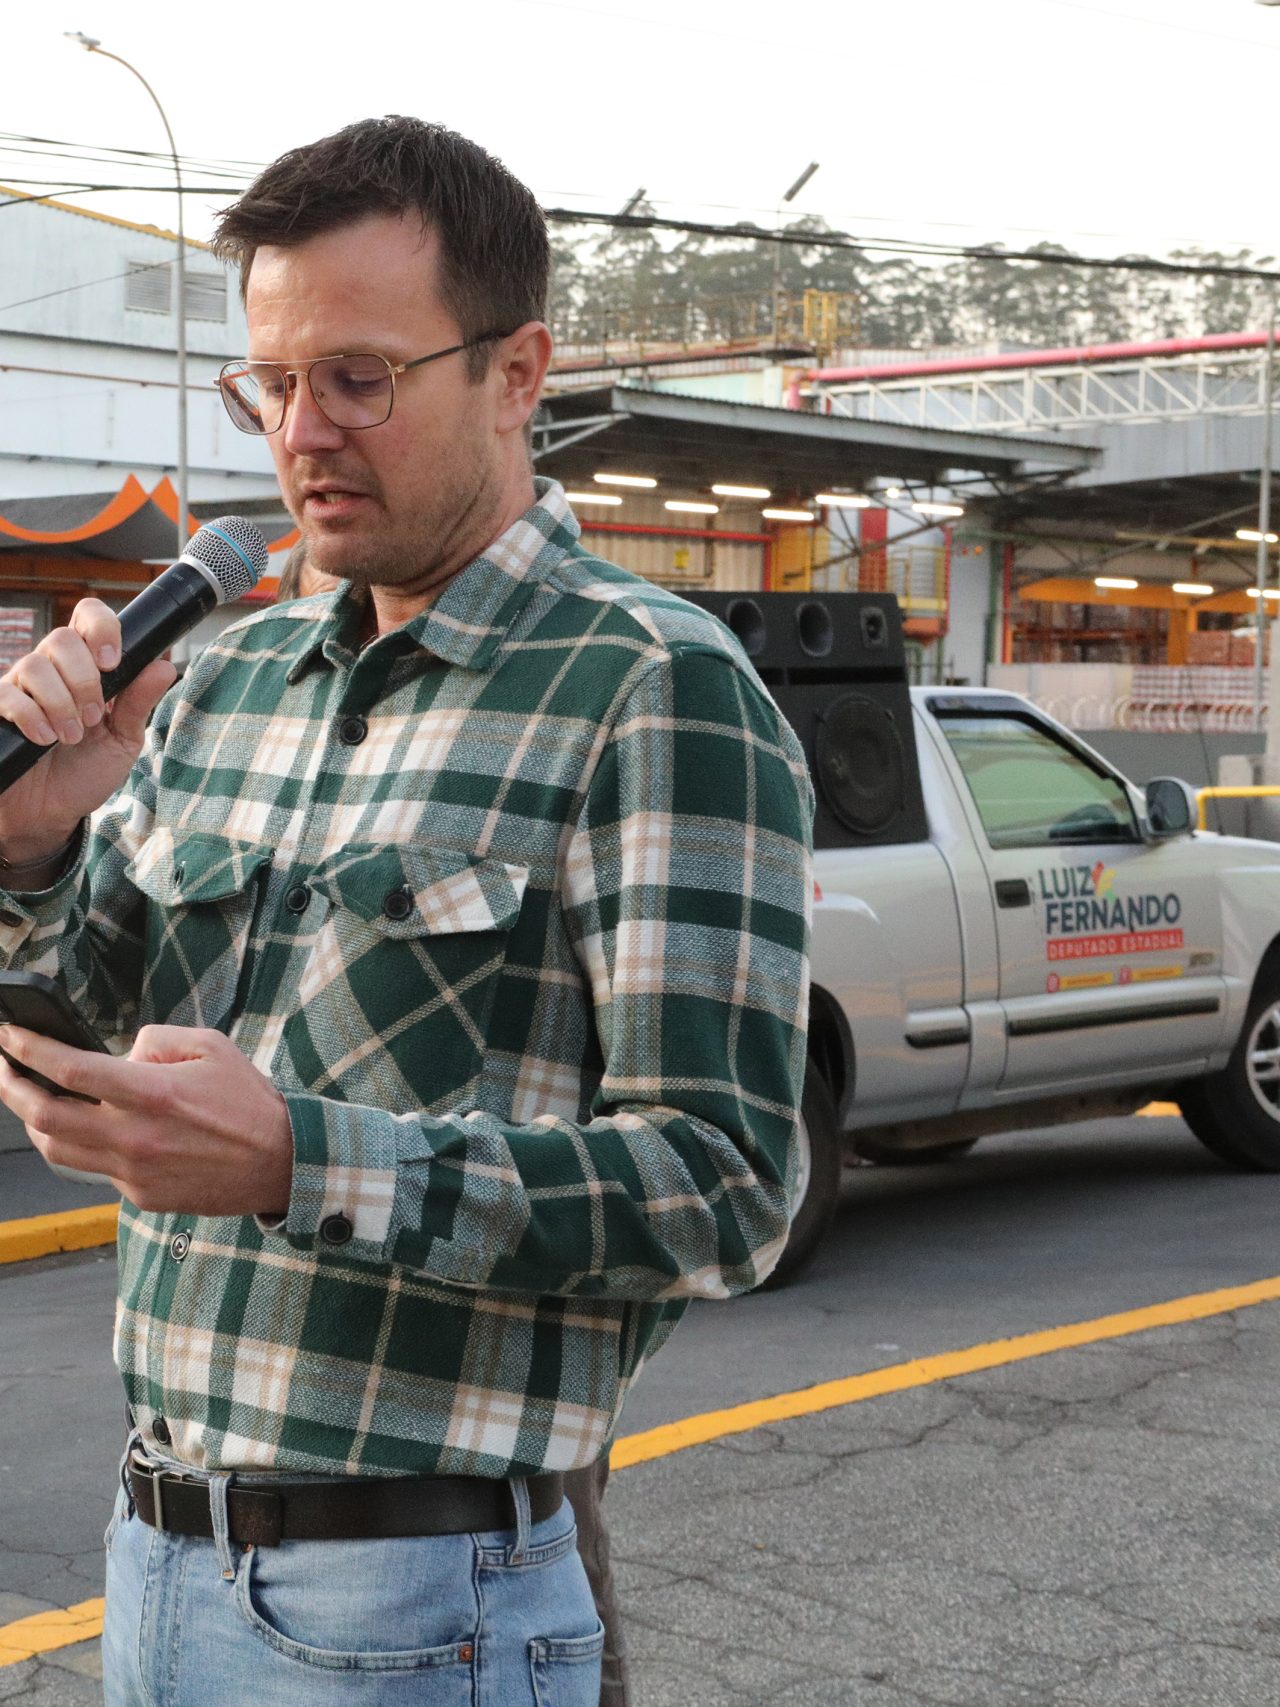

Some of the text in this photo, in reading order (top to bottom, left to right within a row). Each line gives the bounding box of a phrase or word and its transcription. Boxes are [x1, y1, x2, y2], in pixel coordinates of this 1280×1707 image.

[1038, 866, 1094, 899] LUIZ
[1046, 893, 1181, 934] FERNANDO
[1049, 933, 1181, 958] DEPUTADO ESTADUAL
